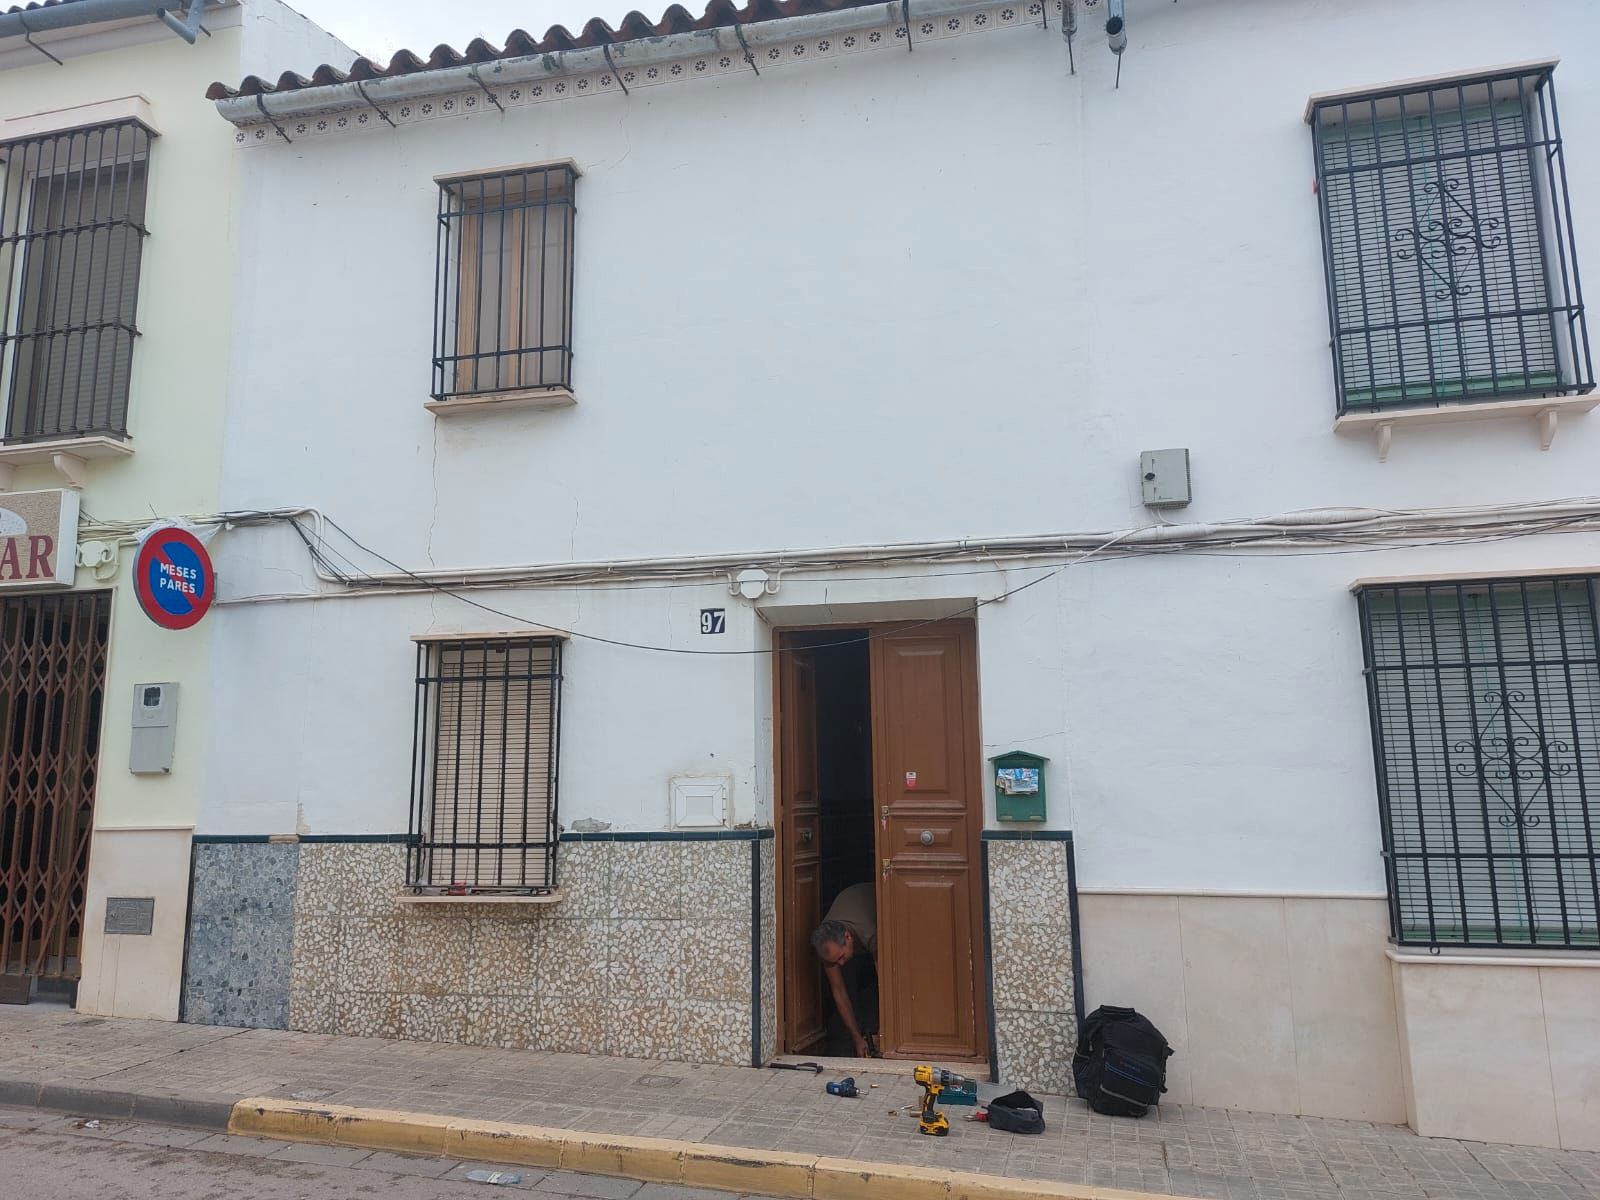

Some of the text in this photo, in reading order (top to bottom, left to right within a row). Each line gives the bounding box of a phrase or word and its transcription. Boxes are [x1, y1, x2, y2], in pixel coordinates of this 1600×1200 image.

[160, 562, 197, 579] MESES
[160, 577, 196, 593] PARES
[701, 611, 725, 633] 97
